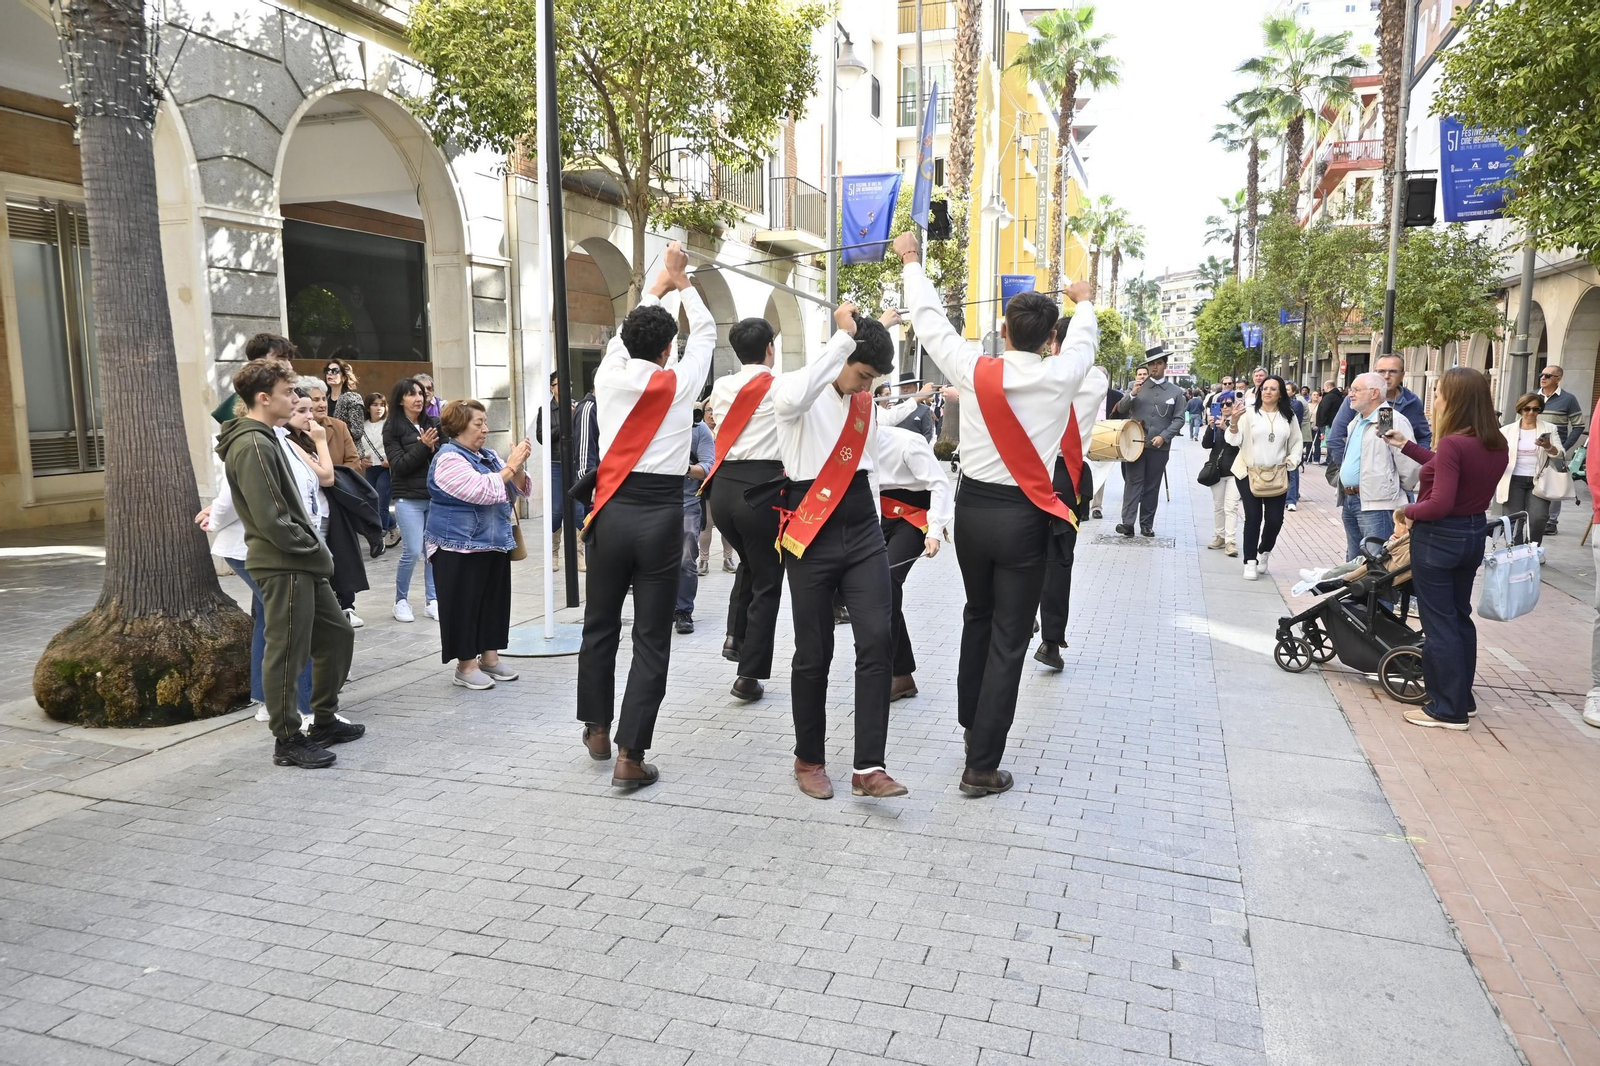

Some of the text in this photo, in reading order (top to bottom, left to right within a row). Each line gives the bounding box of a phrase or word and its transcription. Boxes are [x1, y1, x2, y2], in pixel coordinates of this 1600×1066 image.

[1447, 130, 1459, 152] 51
[1038, 131, 1048, 259] HOTEL TARTESSOS
